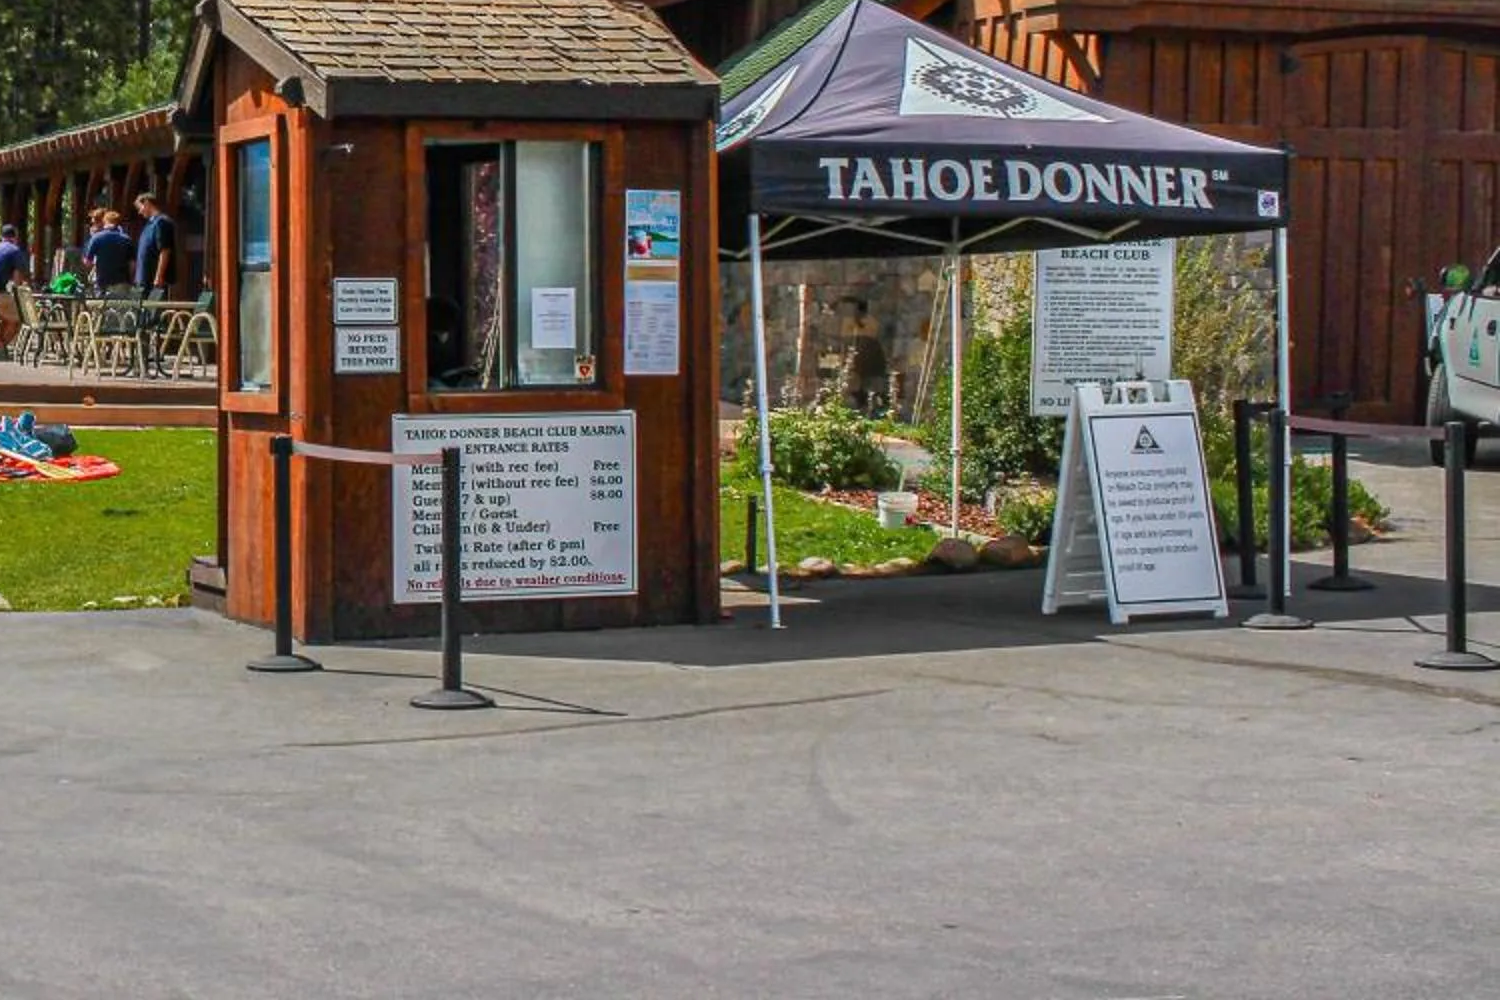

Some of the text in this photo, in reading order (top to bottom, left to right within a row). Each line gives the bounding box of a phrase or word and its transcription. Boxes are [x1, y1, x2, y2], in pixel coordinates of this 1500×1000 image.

[819, 157, 998, 201] TAHOE
[1005, 159, 1213, 209] DONNER
[1061, 249, 1151, 261] BEACH CLUB
[363, 334, 388, 343] PETS
[365, 357, 394, 367] POINT
[405, 425, 625, 440] TAHOE DONNER BEACH CLUB MARINA
[465, 442, 569, 455] ENTRANCE RATES
[471, 460, 504, 474] (with
[508, 463, 529, 472] rec
[535, 460, 559, 473] fee)
[593, 460, 621, 471] Free
[471, 478, 526, 491] (without
[528, 477, 550, 488] rec
[555, 476, 579, 489] fee)
[474, 494, 490, 505] &
[493, 494, 511, 507] up)
[478, 508, 518, 519] Guest
[473, 523, 487, 536] (6
[490, 522, 502, 534] &
[505, 521, 550, 535] Under)
[593, 521, 620, 532] Free
[473, 541, 503, 553] Rate
[507, 540, 542, 553] (after
[547, 539, 556, 550] 6
[559, 538, 585, 553] pm)
[414, 560, 431, 572] all
[472, 557, 526, 570] reduced
[529, 557, 545, 570] by
[408, 579, 422, 590] No
[473, 577, 495, 588] due
[500, 577, 512, 588] to
[515, 575, 560, 587] weather
[563, 572, 627, 584] conditions.
